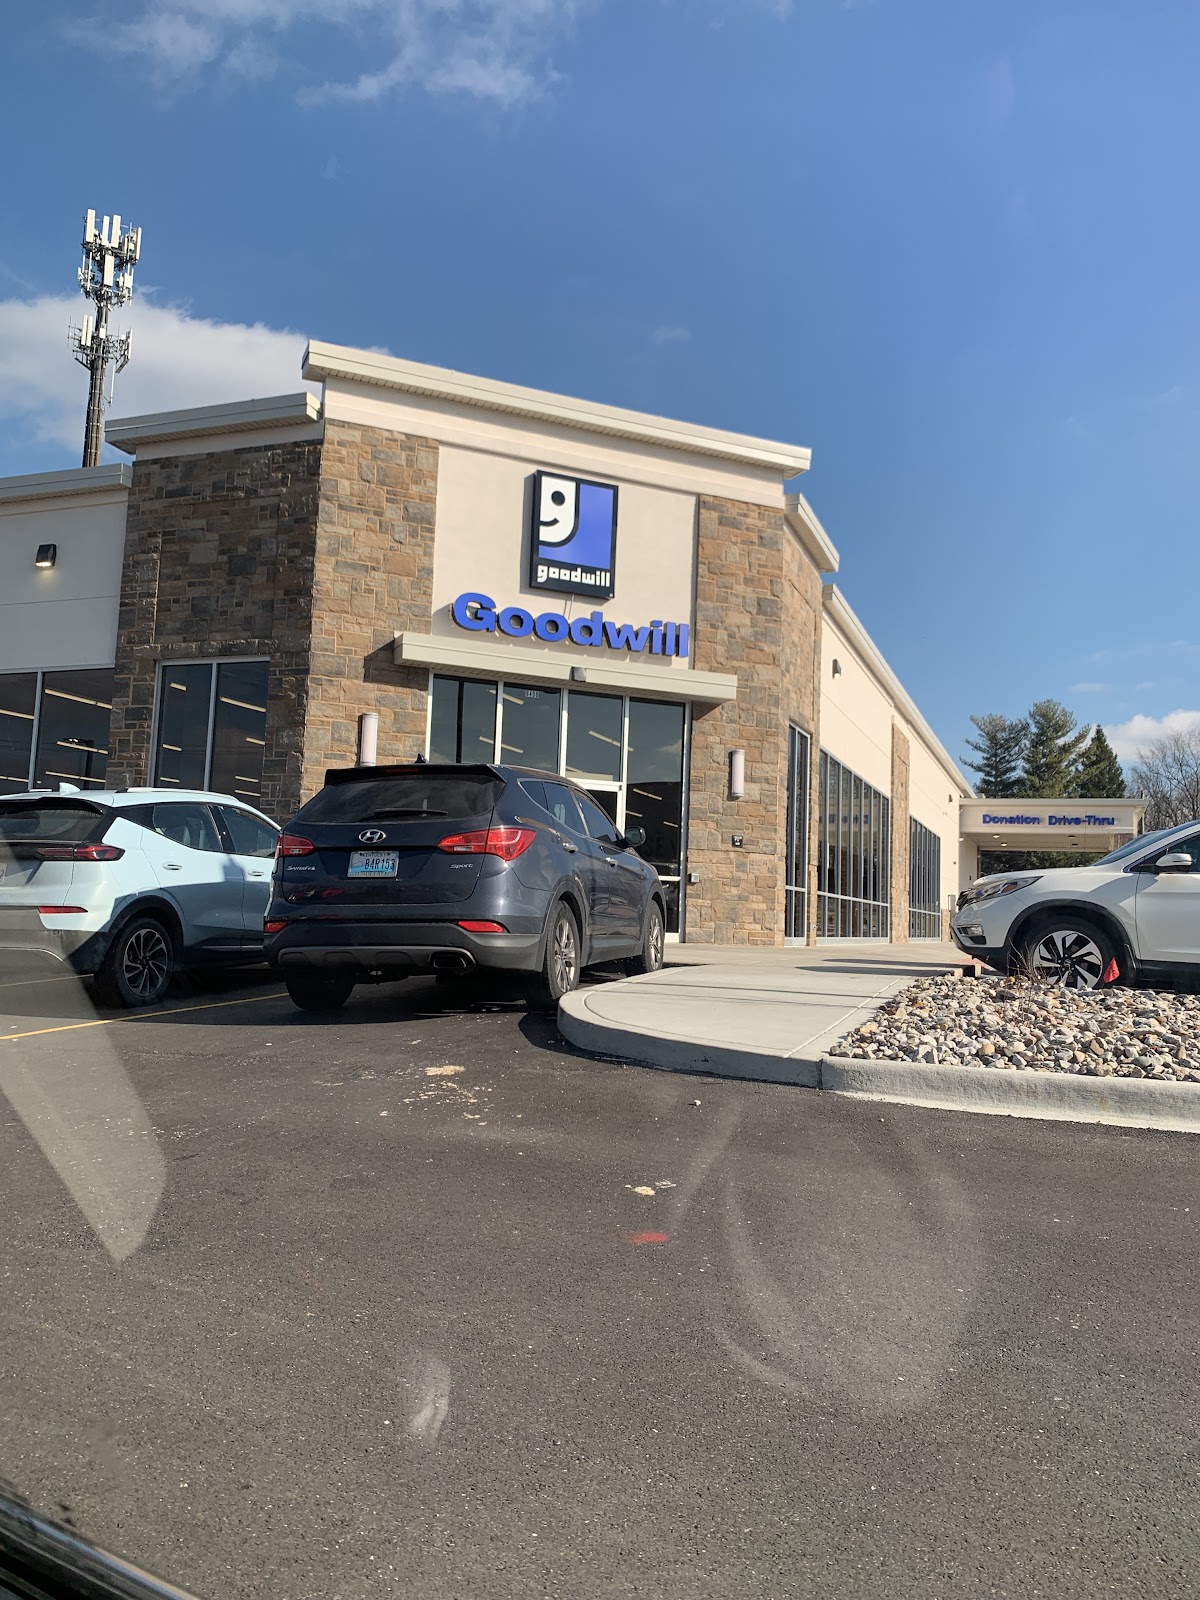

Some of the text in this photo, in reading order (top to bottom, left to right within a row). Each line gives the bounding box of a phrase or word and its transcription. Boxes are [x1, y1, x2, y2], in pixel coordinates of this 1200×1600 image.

[537, 565, 611, 587] goodwill
[451, 592, 689, 658] Goodwill
[982, 814, 1115, 826] Donation Drive-Thru
